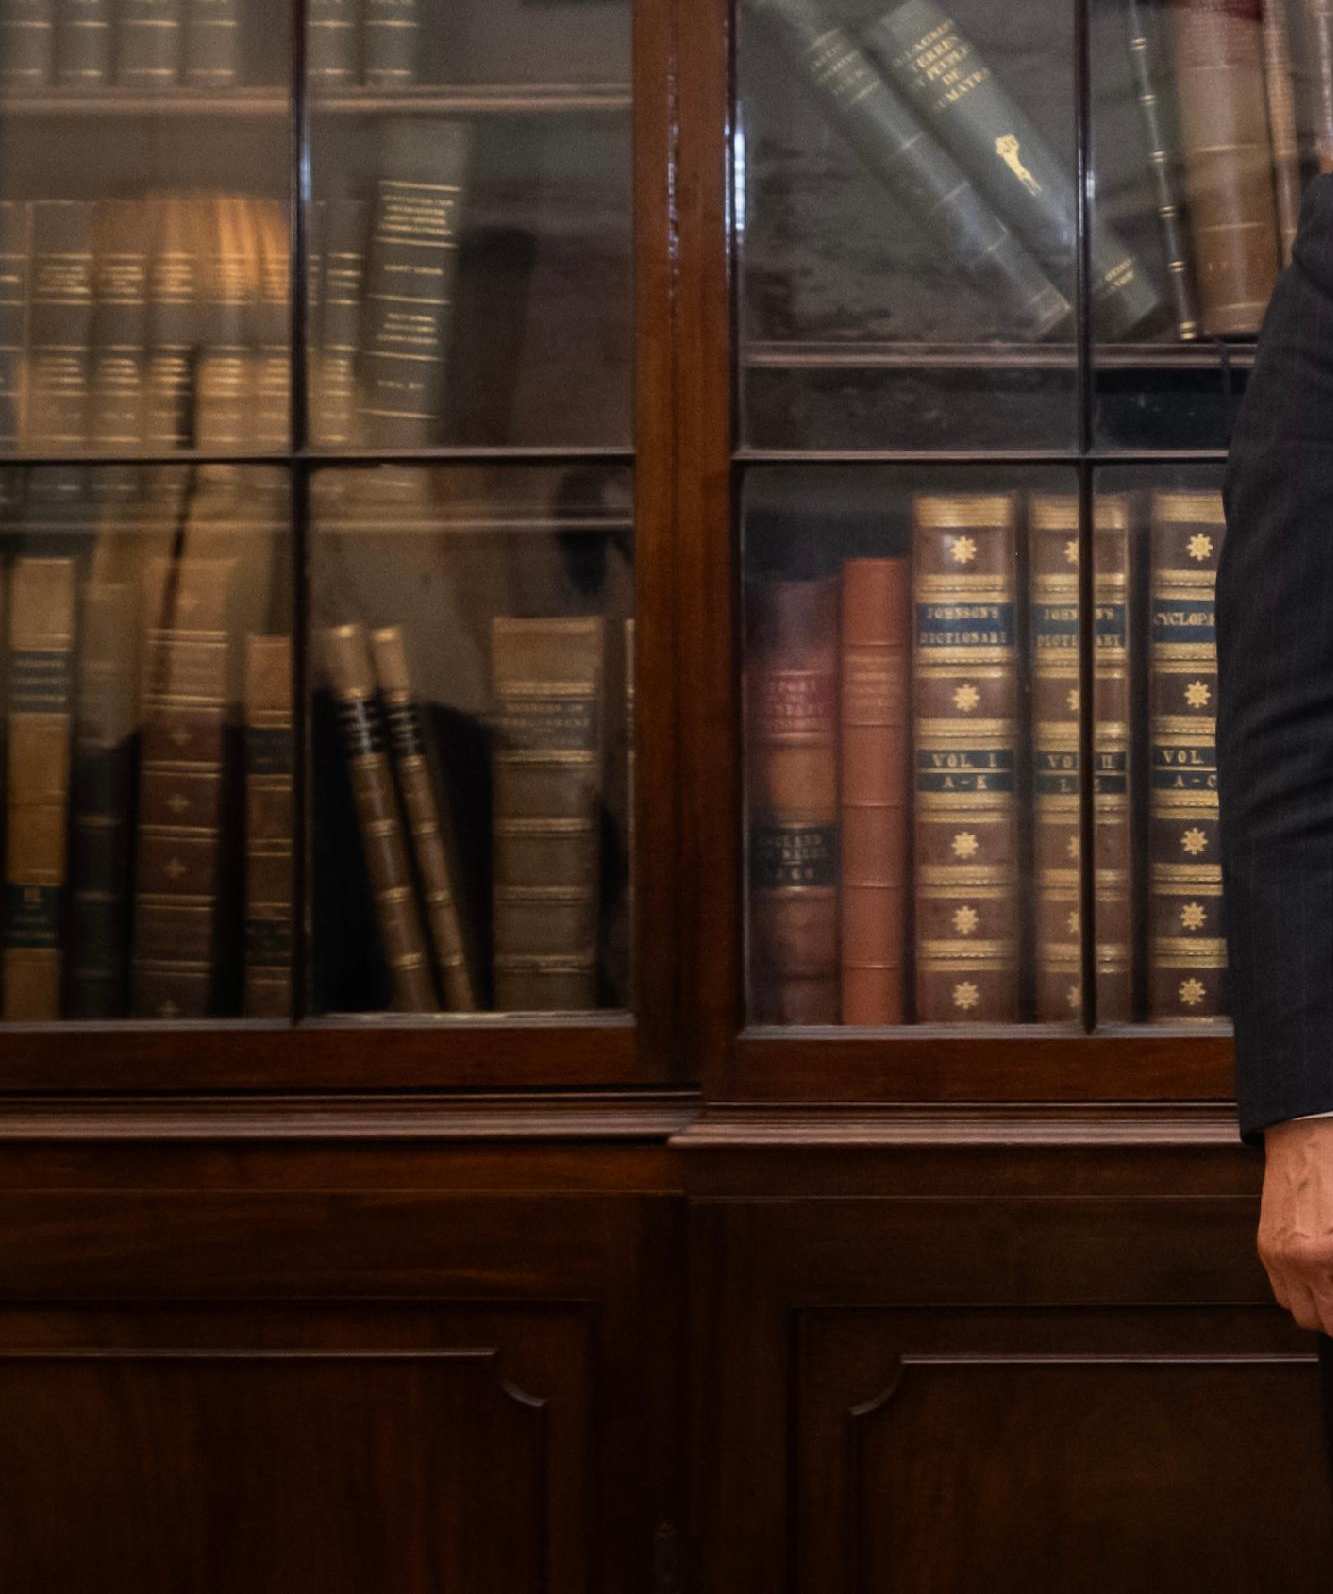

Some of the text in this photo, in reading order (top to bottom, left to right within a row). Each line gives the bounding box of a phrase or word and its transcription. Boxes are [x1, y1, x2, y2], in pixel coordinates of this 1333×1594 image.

[926, 606, 999, 621] JOHNSON'S
[919, 632, 1007, 645] DICTIONARY
[989, 754, 998, 768] I
